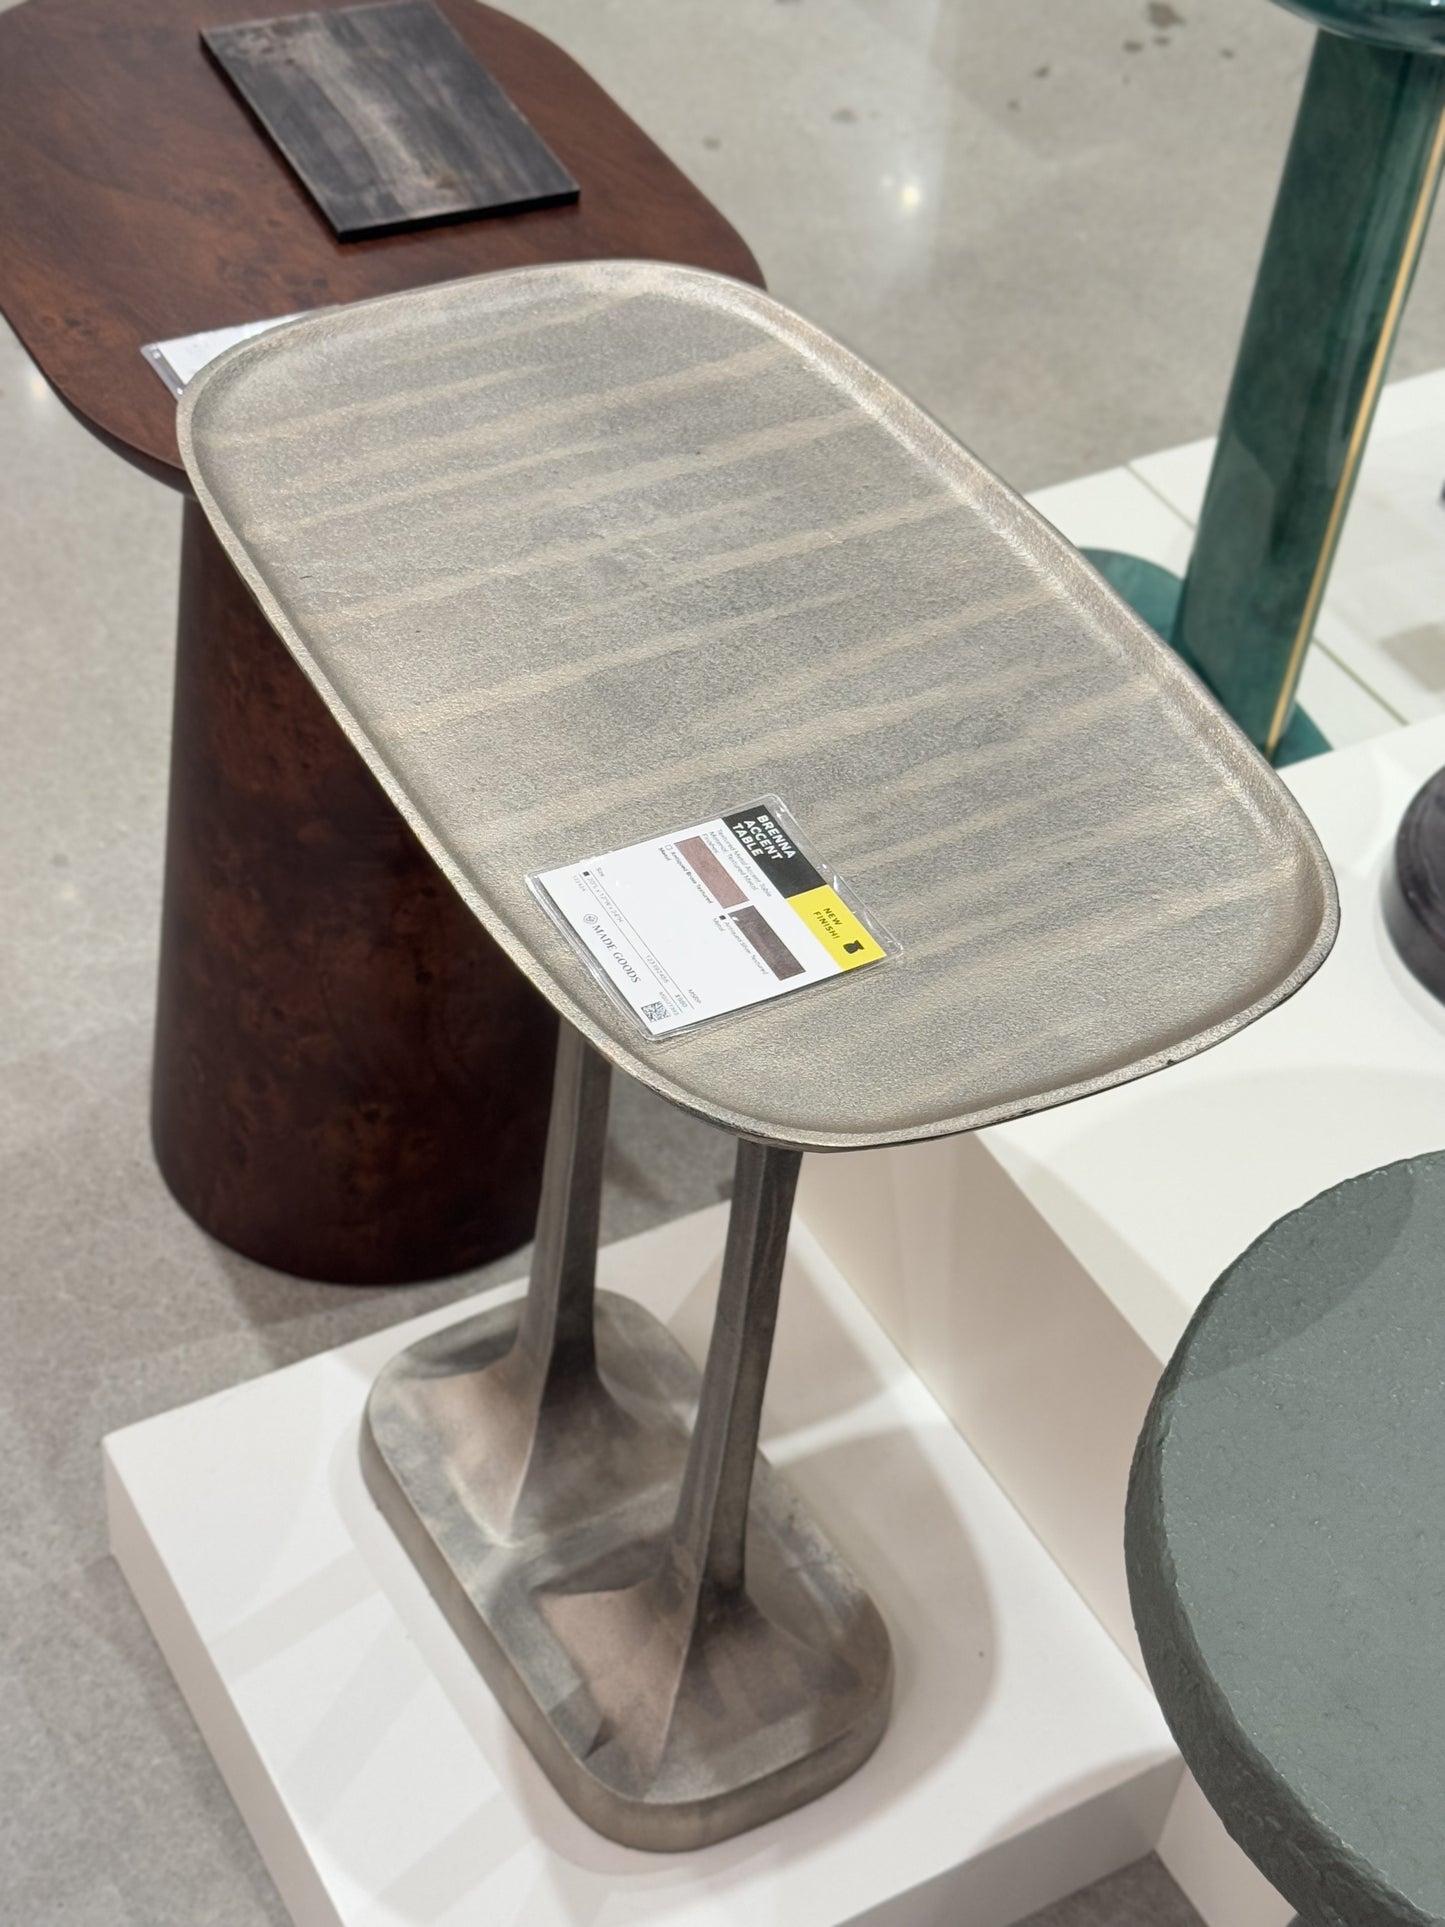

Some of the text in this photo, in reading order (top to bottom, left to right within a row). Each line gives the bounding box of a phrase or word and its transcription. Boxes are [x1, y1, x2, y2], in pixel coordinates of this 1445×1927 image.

[658, 847, 672, 861] Metal
[732, 822, 764, 857] TABLE
[743, 820, 783, 859] ACCENT
[756, 814, 796, 859] BRENNA
[670, 851, 689, 872] Antiqued
[696, 883, 714, 905] Textured
[717, 828, 772, 897] Textured Metal Accent Table
[726, 853, 747, 876] Textured
[742, 874, 759, 891] Metal
[813, 911, 840, 939] FINISH!
[823, 907, 843, 925] NEW
[592, 924, 642, 983] MADE GOODS
[750, 954, 769, 975] Textured
